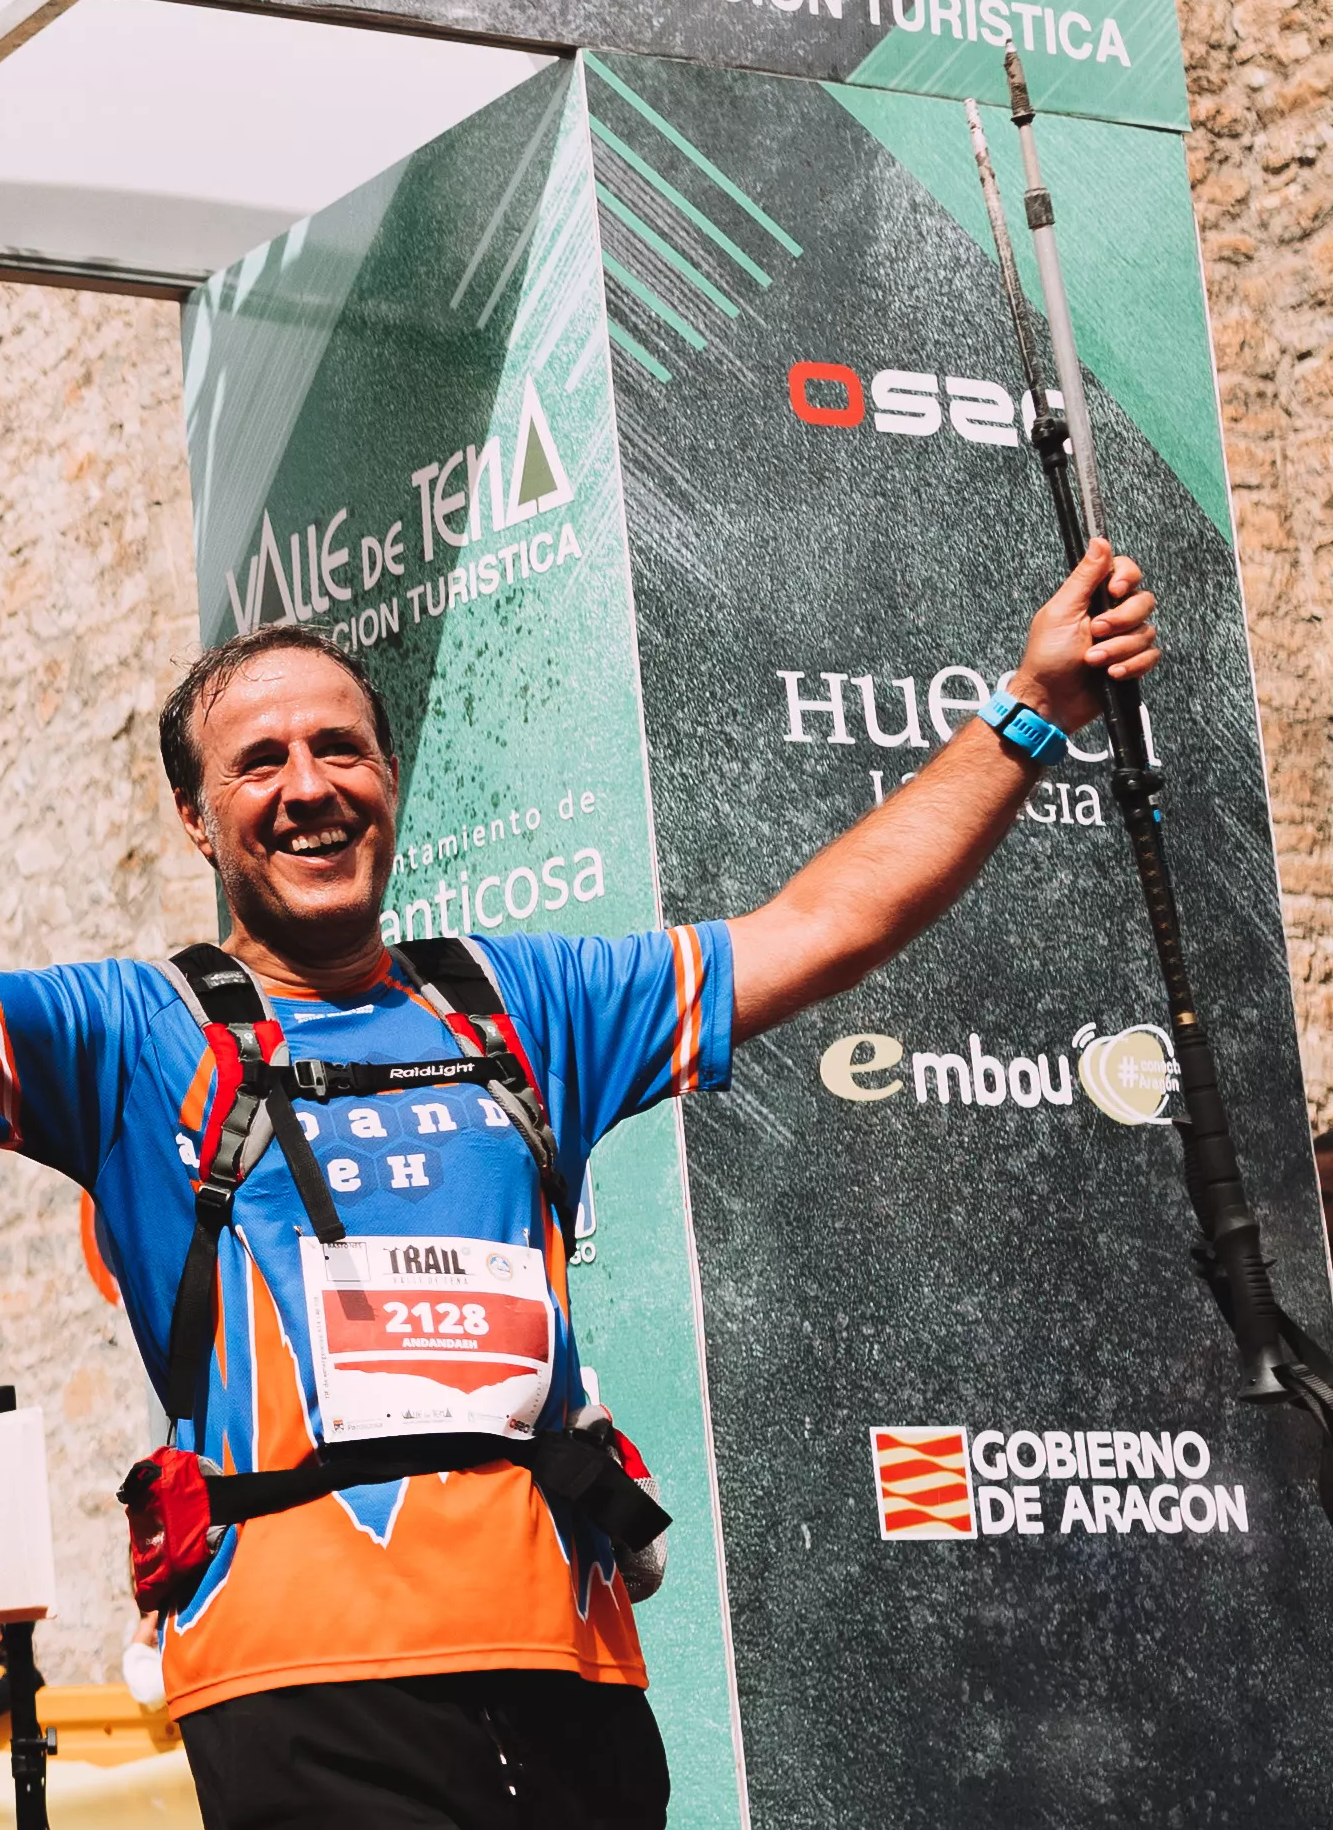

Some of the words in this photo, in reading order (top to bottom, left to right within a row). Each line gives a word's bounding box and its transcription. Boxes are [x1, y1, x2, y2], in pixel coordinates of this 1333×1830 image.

[225, 507, 352, 636] VALLE
[408, 523, 583, 620] TURISTICA
[391, 804, 541, 877] ntamiento
[559, 786, 597, 822] de
[381, 846, 607, 946] anticosa
[388, 1061, 476, 1080] RaidLight
[819, 1032, 1073, 1108] embou
[383, 1244, 468, 1276] TRAIL
[382, 1300, 490, 1336] 2128
[401, 1337, 479, 1350] ANDANDAEH
[971, 1429, 1211, 1480] GOBIERNO
[979, 1486, 1045, 1535] DE
[1060, 1484, 1249, 1536] ARAGON
